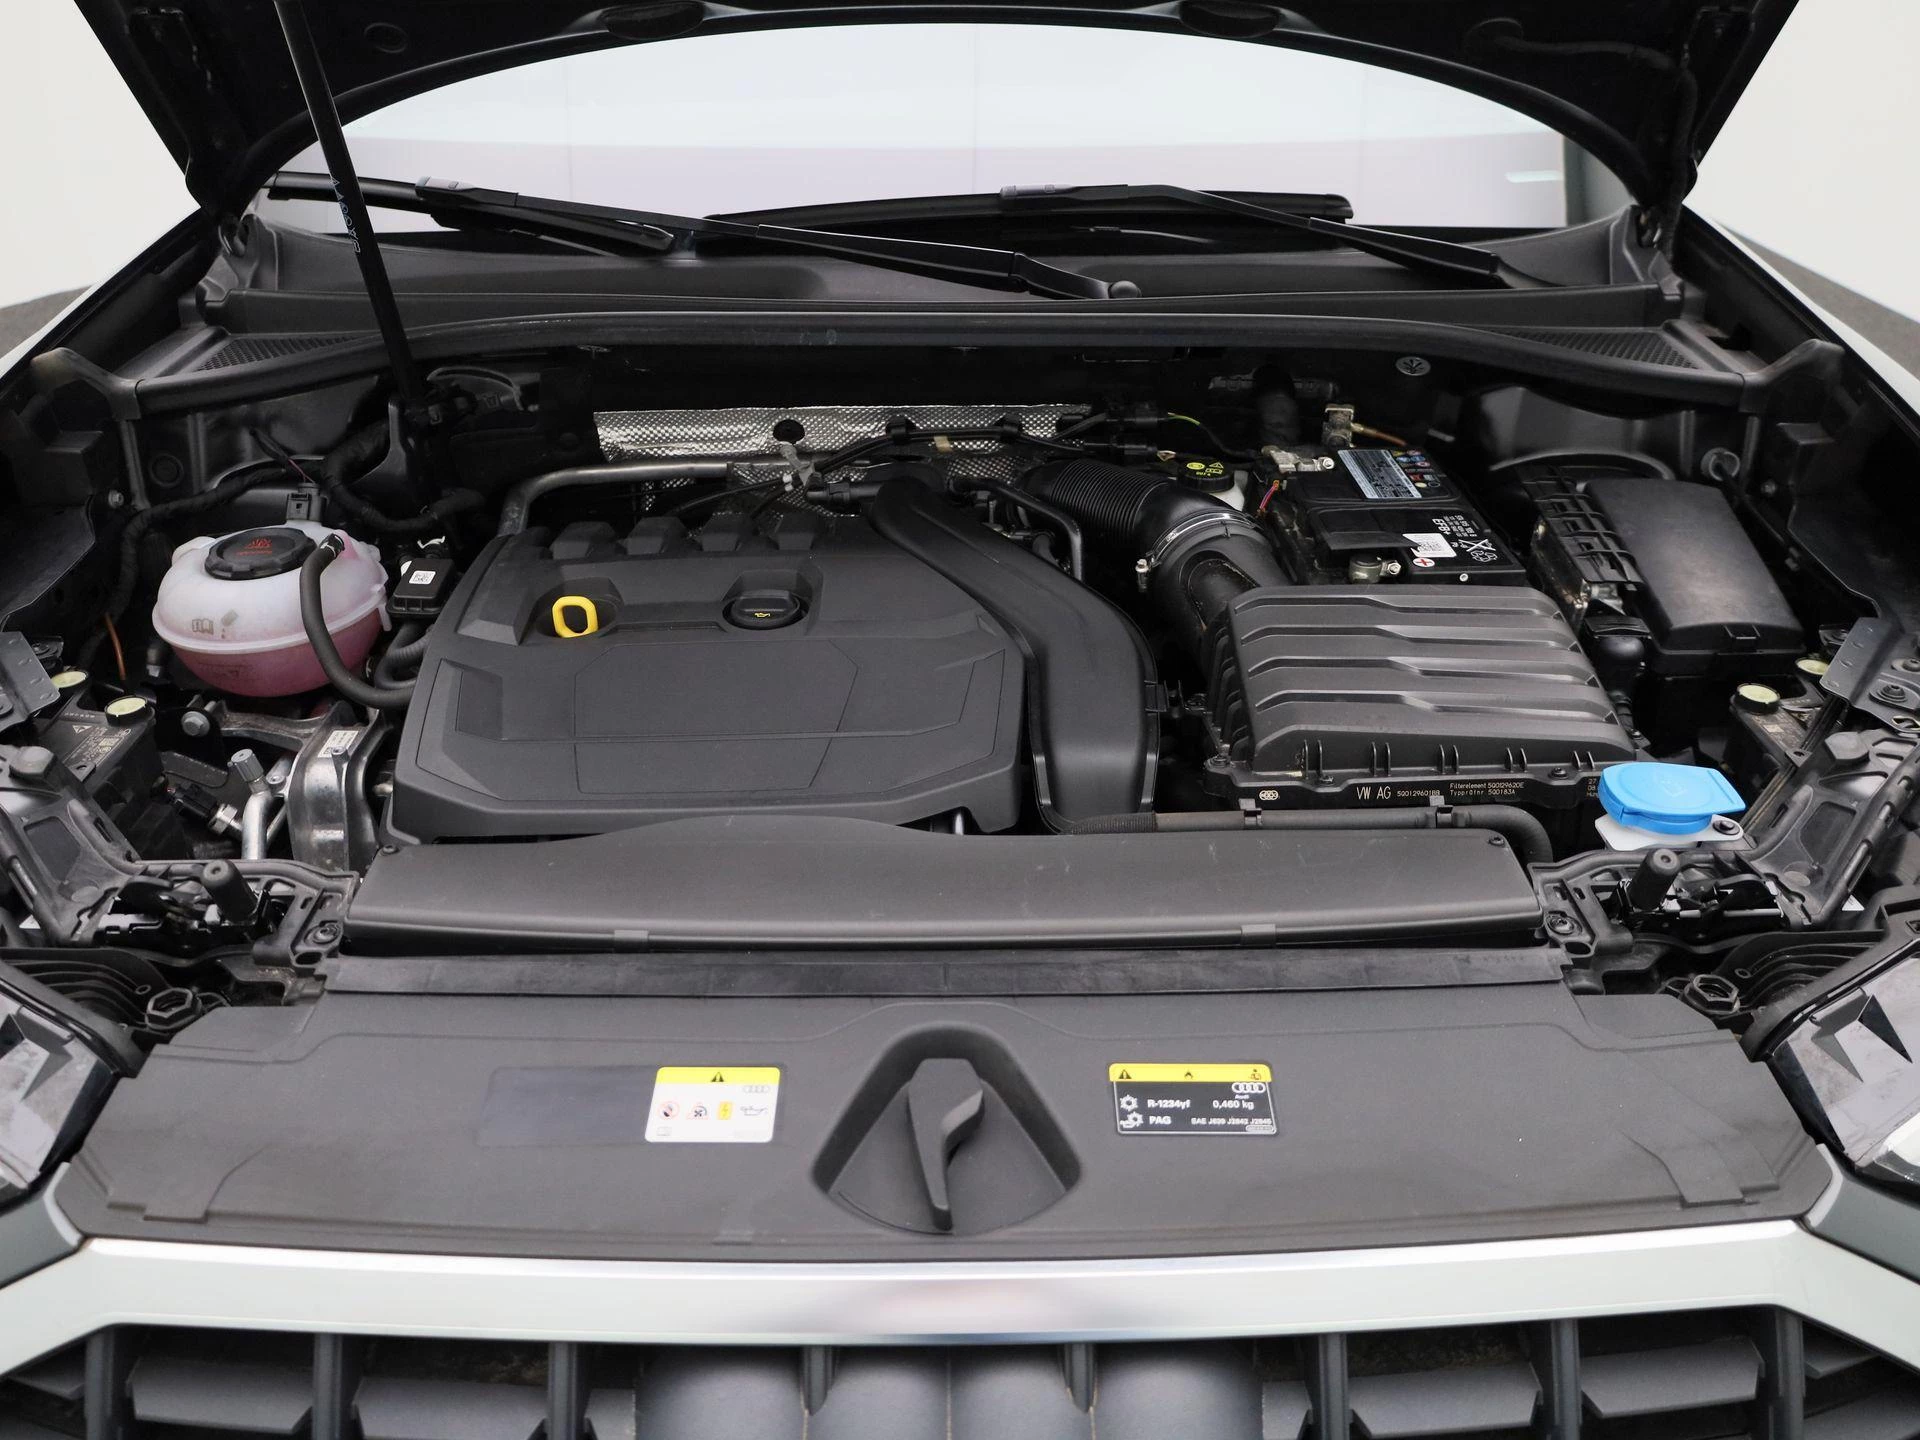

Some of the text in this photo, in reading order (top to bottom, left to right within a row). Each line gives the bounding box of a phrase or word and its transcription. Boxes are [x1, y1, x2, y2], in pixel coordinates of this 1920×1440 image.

[1356, 786, 1371, 800] VW
[1376, 785, 1391, 800] AG
[1147, 1099, 1191, 1110] R-1234yf
[1242, 1100, 1254, 1110] kg
[1149, 1115, 1172, 1125] PAG
[1191, 1117, 1207, 1125] SAE
